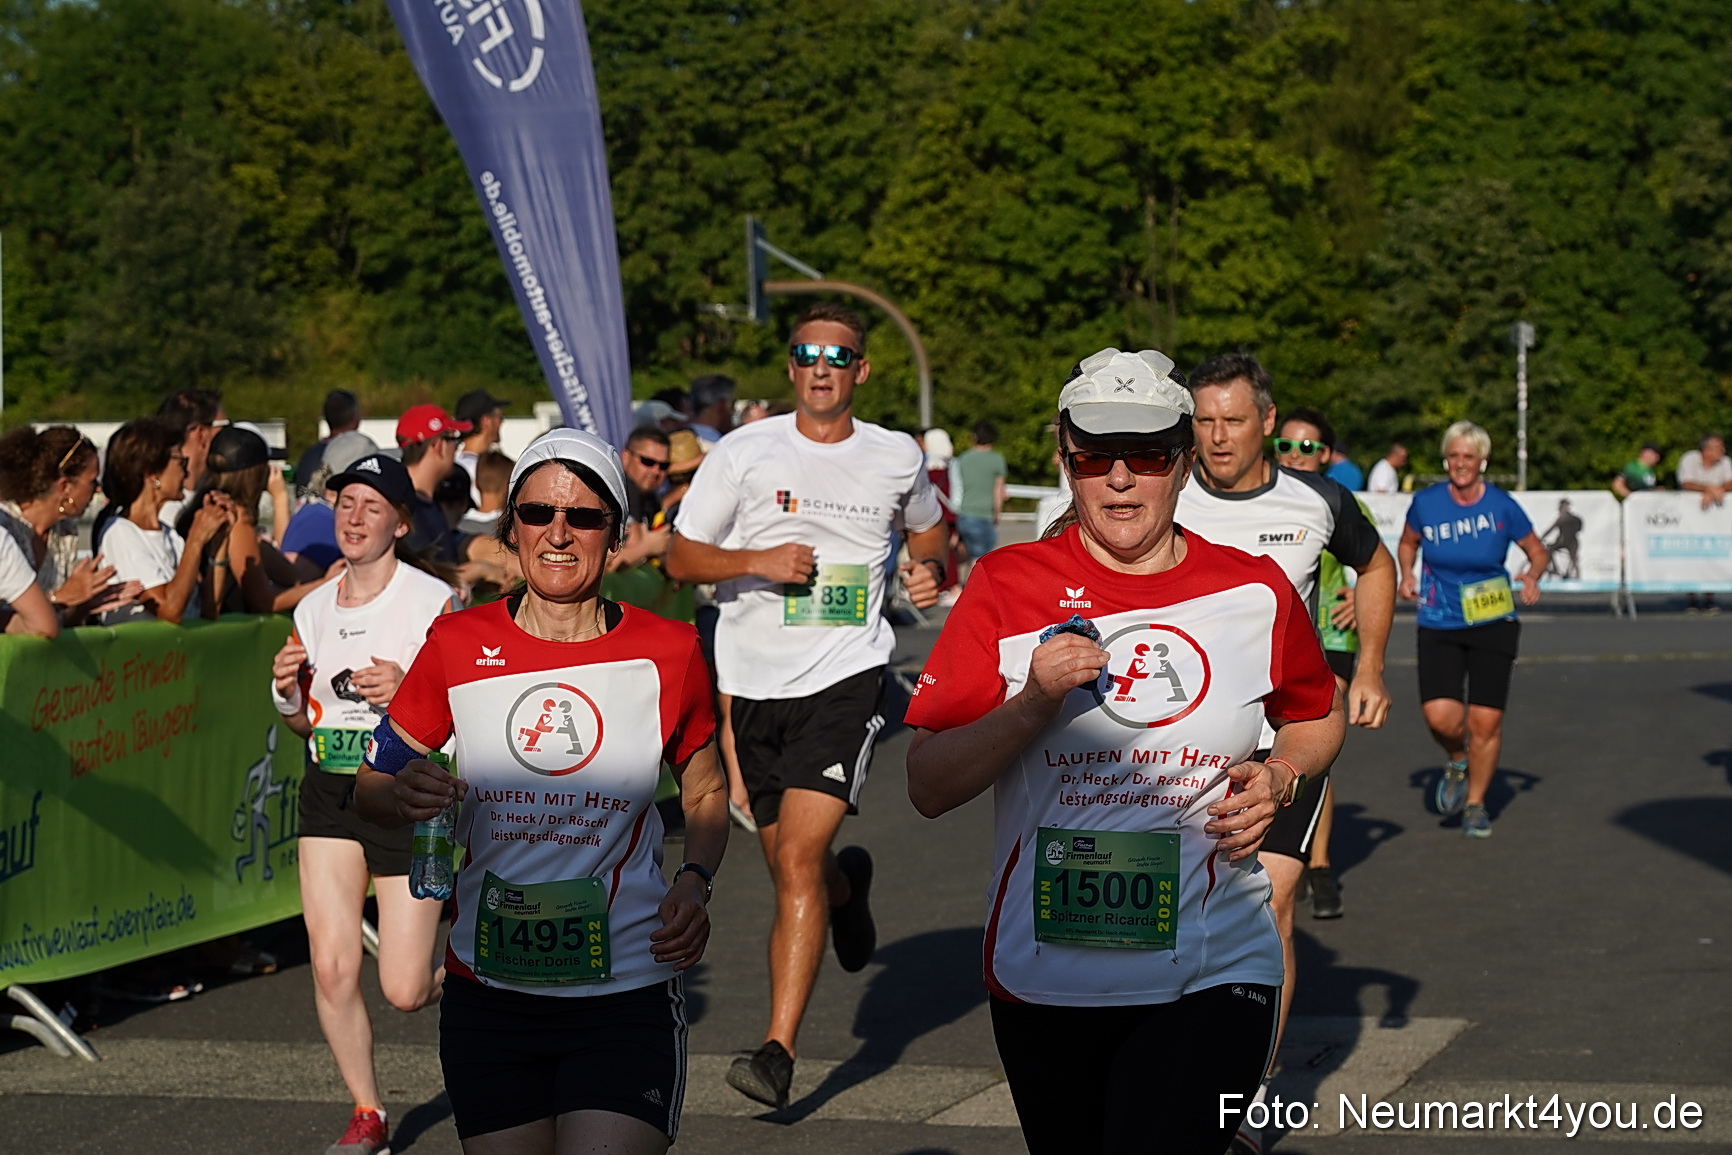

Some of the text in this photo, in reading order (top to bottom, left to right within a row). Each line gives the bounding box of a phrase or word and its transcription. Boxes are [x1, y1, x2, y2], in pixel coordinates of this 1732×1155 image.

[803, 498, 880, 516] SCHWARZ
[1259, 533, 1294, 543] swn
[1059, 599, 1092, 609] erima
[476, 657, 506, 667] erima
[31, 658, 117, 733] Gesunde
[69, 717, 128, 781] laufen
[1061, 774, 1080, 785] Dr.
[1083, 773, 1118, 786] Heck
[1132, 773, 1152, 786] Dr.
[1157, 774, 1206, 790] Röschl
[1059, 790, 1194, 810] Leistungsdiagnostik
[490, 811, 505, 824] Dr.
[506, 812, 537, 825] Heck
[547, 814, 565, 827] Dr.
[568, 814, 609, 829] Röschl
[491, 828, 602, 849] Leistungsdiagnostik
[1066, 851, 1113, 861] Firmenlauf
[1055, 869, 1154, 911] 1500
[499, 901, 542, 911] Firmenlauf
[1040, 880, 1051, 919] RUN
[1157, 880, 1172, 933] 2022
[1049, 909, 1157, 926] Spitzner Ricarda
[480, 921, 489, 958] RUN
[491, 916, 585, 953] 1495
[588, 920, 603, 968] 2022
[495, 951, 581, 967] Fischer Doris
[1247, 989, 1267, 1006] JAKO
